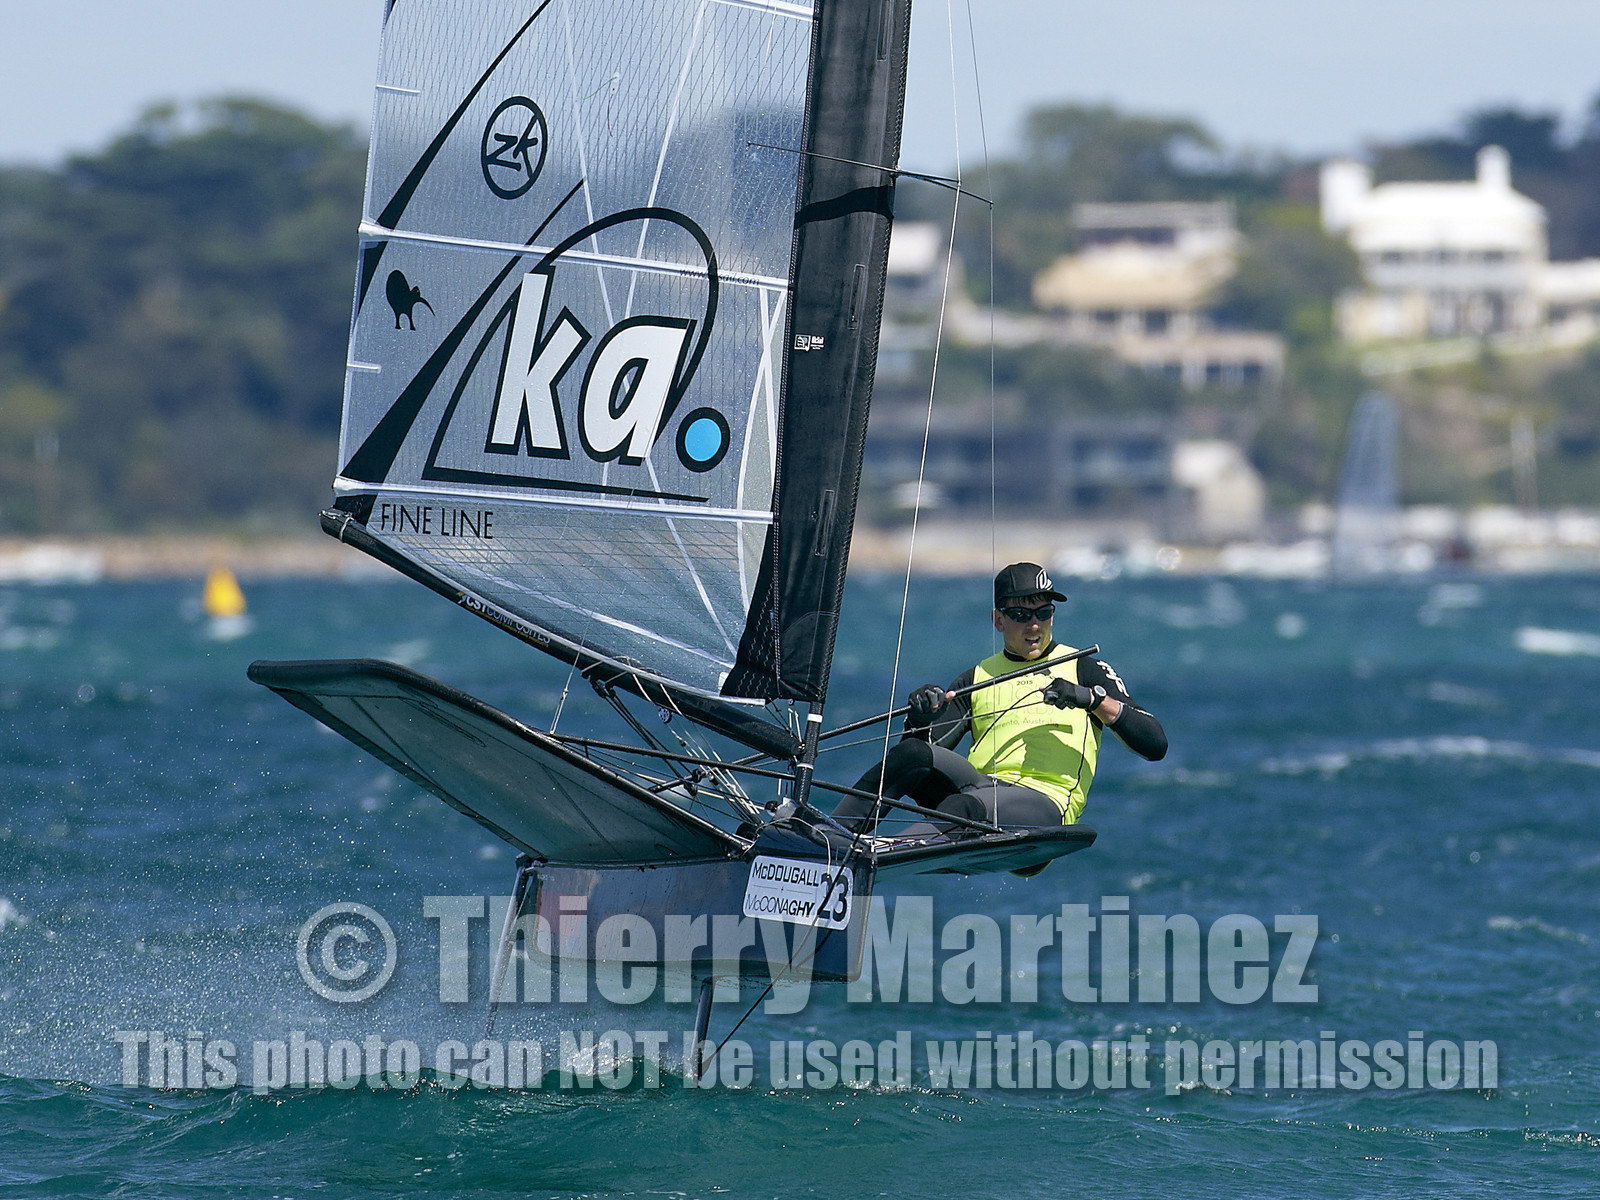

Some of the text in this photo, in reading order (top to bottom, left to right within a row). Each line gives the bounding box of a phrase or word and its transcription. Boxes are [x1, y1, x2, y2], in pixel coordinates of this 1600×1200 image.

[381, 504, 493, 539] FINE LINE
[752, 862, 819, 887] McDOUGALL
[818, 872, 849, 922] 23
